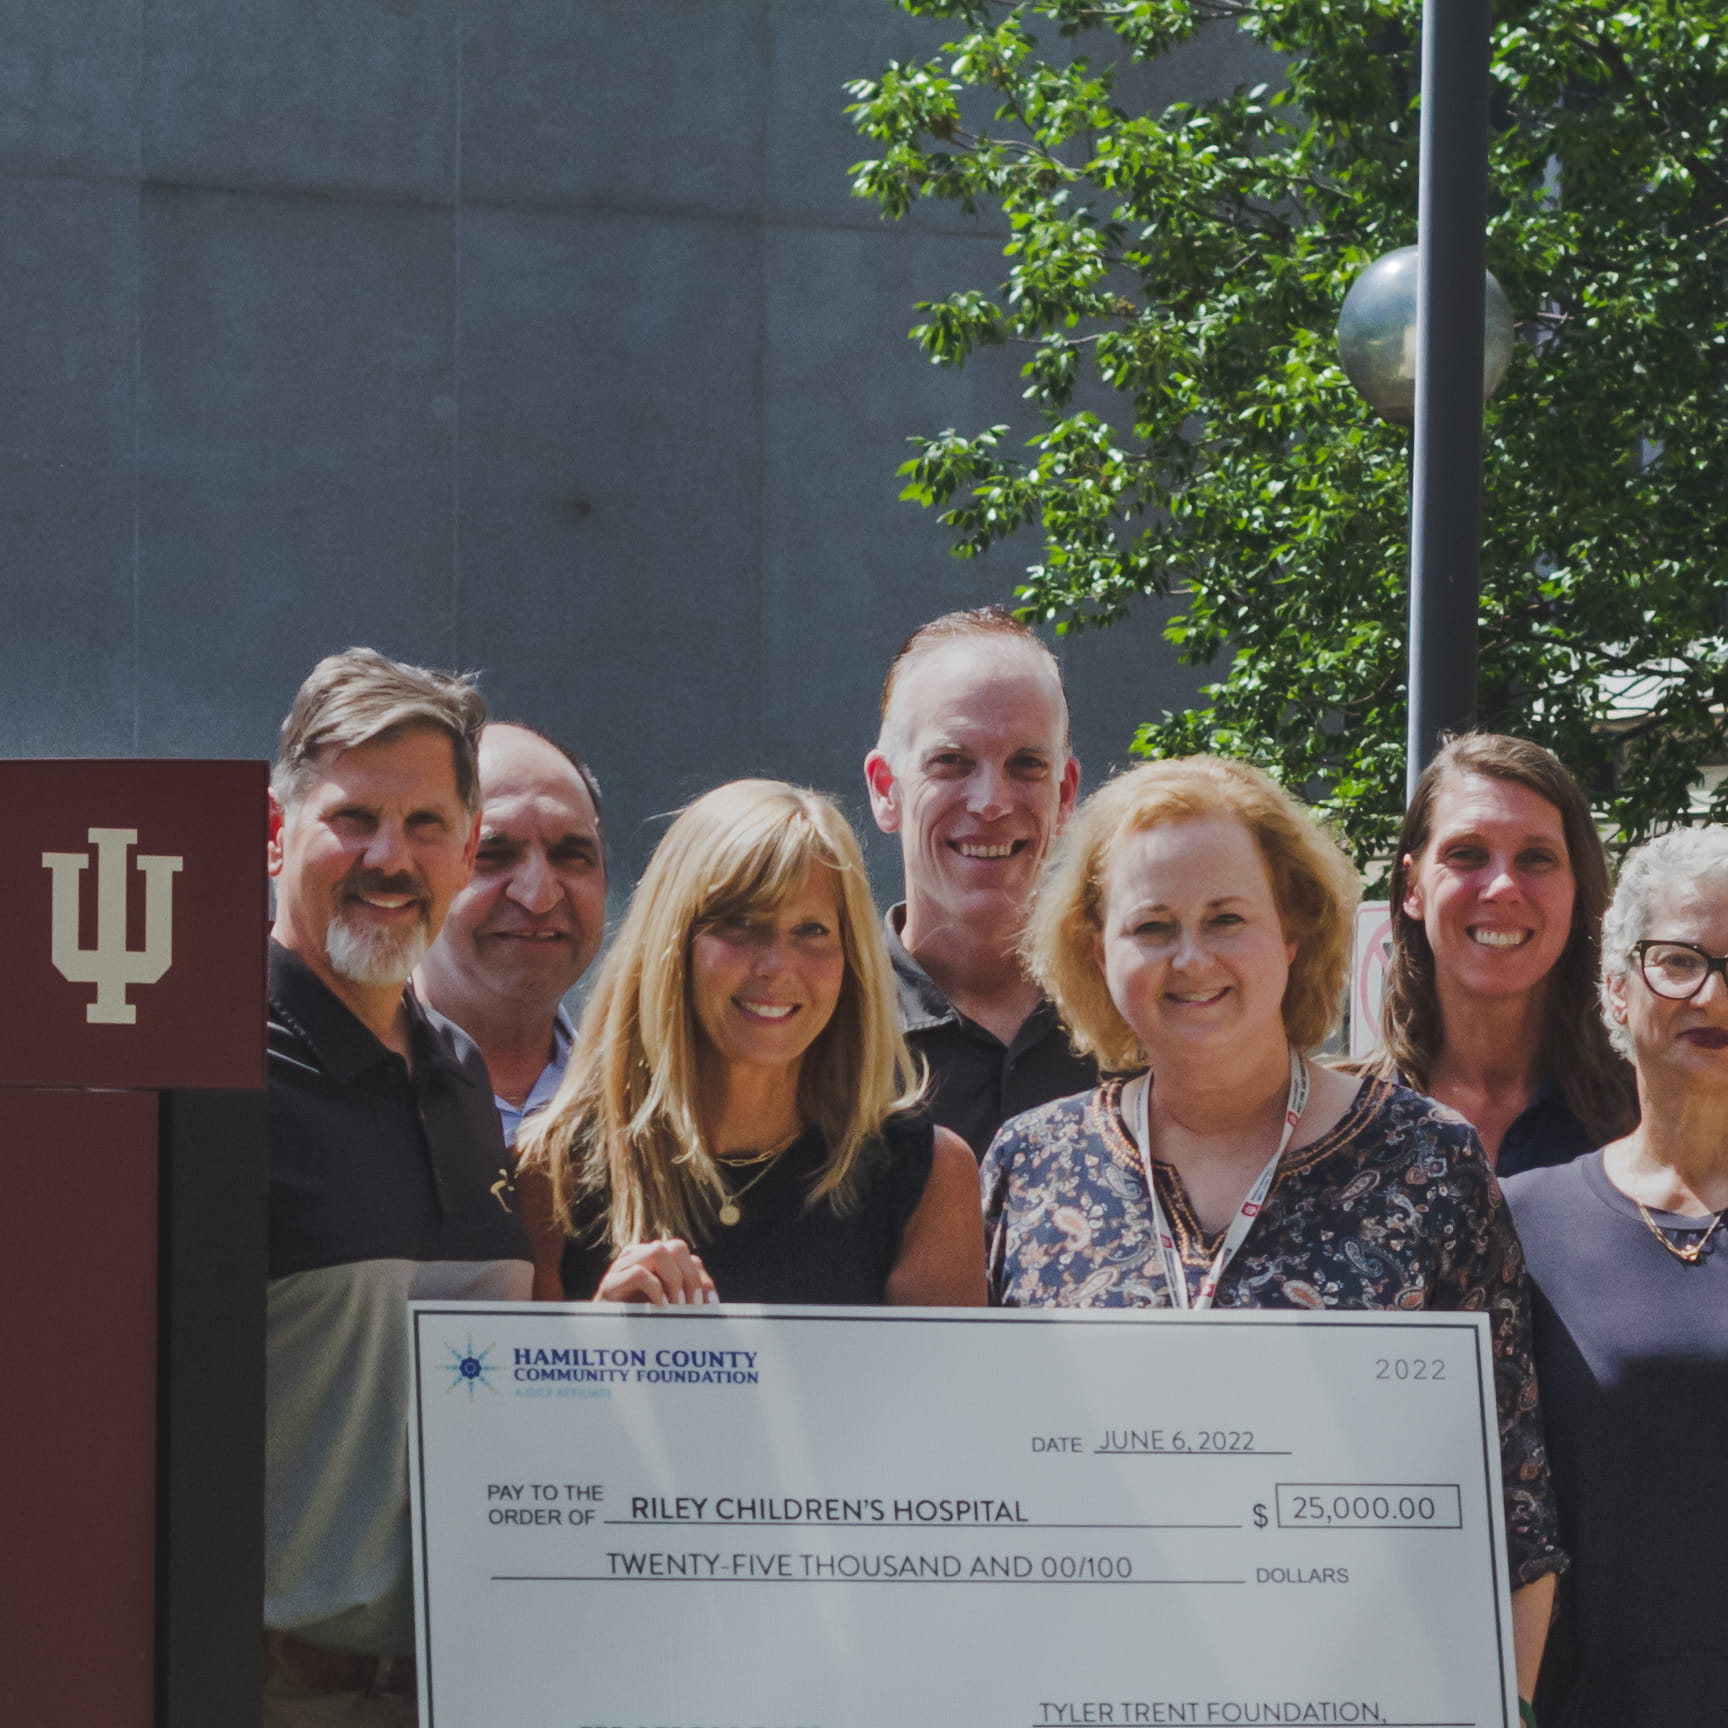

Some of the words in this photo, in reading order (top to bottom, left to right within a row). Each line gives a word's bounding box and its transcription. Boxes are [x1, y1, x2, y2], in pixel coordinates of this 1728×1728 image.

[514, 1348, 646, 1367] HAMILTON
[655, 1350, 758, 1369] COUNTY
[1375, 1359, 1447, 1380] 2022
[514, 1368, 629, 1382] COMMUNITY
[637, 1369, 759, 1384] FOUNDATION
[1032, 1436, 1083, 1452] DATE
[1099, 1430, 1164, 1451] JUNE
[1173, 1432, 1192, 1453] 6,
[1198, 1431, 1255, 1451] 2022
[488, 1484, 524, 1500] PAY
[532, 1484, 558, 1501] TO
[564, 1485, 604, 1501] THE
[488, 1509, 561, 1525] ORDER
[568, 1509, 596, 1526] OF
[632, 1497, 707, 1519] RILEY
[894, 1500, 1029, 1522] HOSPITAL
[1252, 1503, 1269, 1528] $
[1293, 1496, 1436, 1525] 25,000.00
[606, 1552, 793, 1576] TWENTY-FIVE
[800, 1555, 961, 1577] THOUSAND
[970, 1556, 1033, 1578] AND
[1041, 1557, 1132, 1578] 00/100
[1256, 1568, 1349, 1584] DOLLARS
[1040, 1702, 1114, 1723] TYLER
[1121, 1702, 1199, 1723] TRENT
[1207, 1702, 1387, 1726] FOUNDATION,
